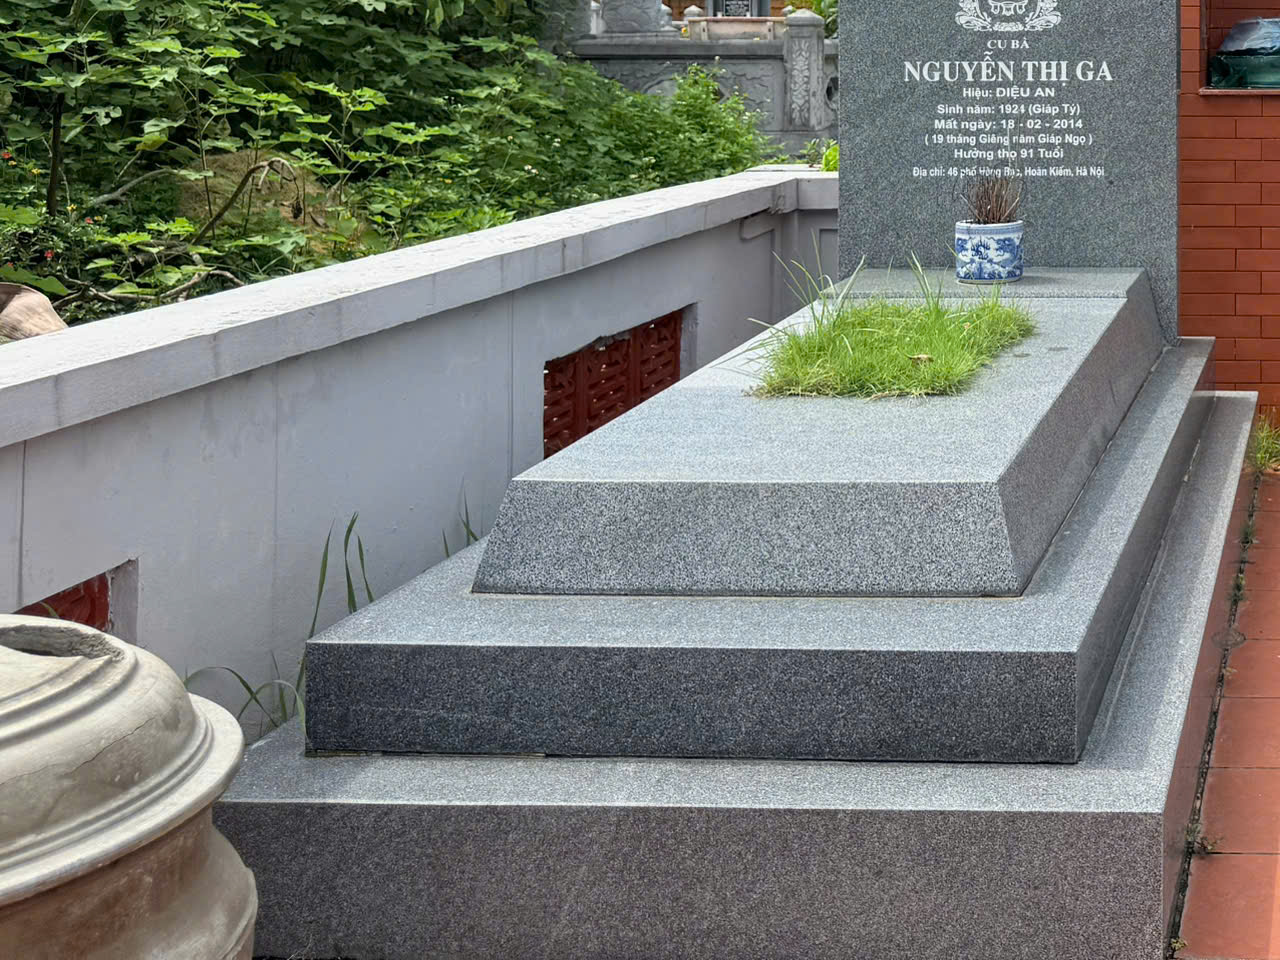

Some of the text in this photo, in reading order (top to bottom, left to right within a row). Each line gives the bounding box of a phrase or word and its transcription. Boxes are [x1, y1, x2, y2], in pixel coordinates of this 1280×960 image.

[987, 39, 1007, 51] CỤ
[903, 50, 1113, 87] NGUYỄN THỊ GA
[962, 85, 1055, 100] Hiệu: DIỆU AN
[937, 103, 1081, 117] Sinh năm: 1924 (Giáp Tý)
[934, 118, 959, 129] Mất
[961, 119, 997, 131] ngày:
[1000, 119, 1015, 129] 18
[1027, 119, 1042, 129] 02
[1053, 119, 1084, 129] 2014
[946, 134, 976, 146] tháng
[979, 133, 1010, 146] Giêng
[1012, 134, 1036, 144] năm
[1037, 133, 1062, 146] Giáp
[1064, 133, 1087, 146] Ngọ
[953, 145, 1064, 161] Hưởng thọ 91 Tuổi
[912, 166, 928, 179] Địa
[947, 167, 959, 177] 46
[960, 165, 977, 179] phố
[1024, 166, 1048, 177] Hoàn
[1076, 166, 1088, 177] Hà
[1089, 166, 1105, 179] Nội
